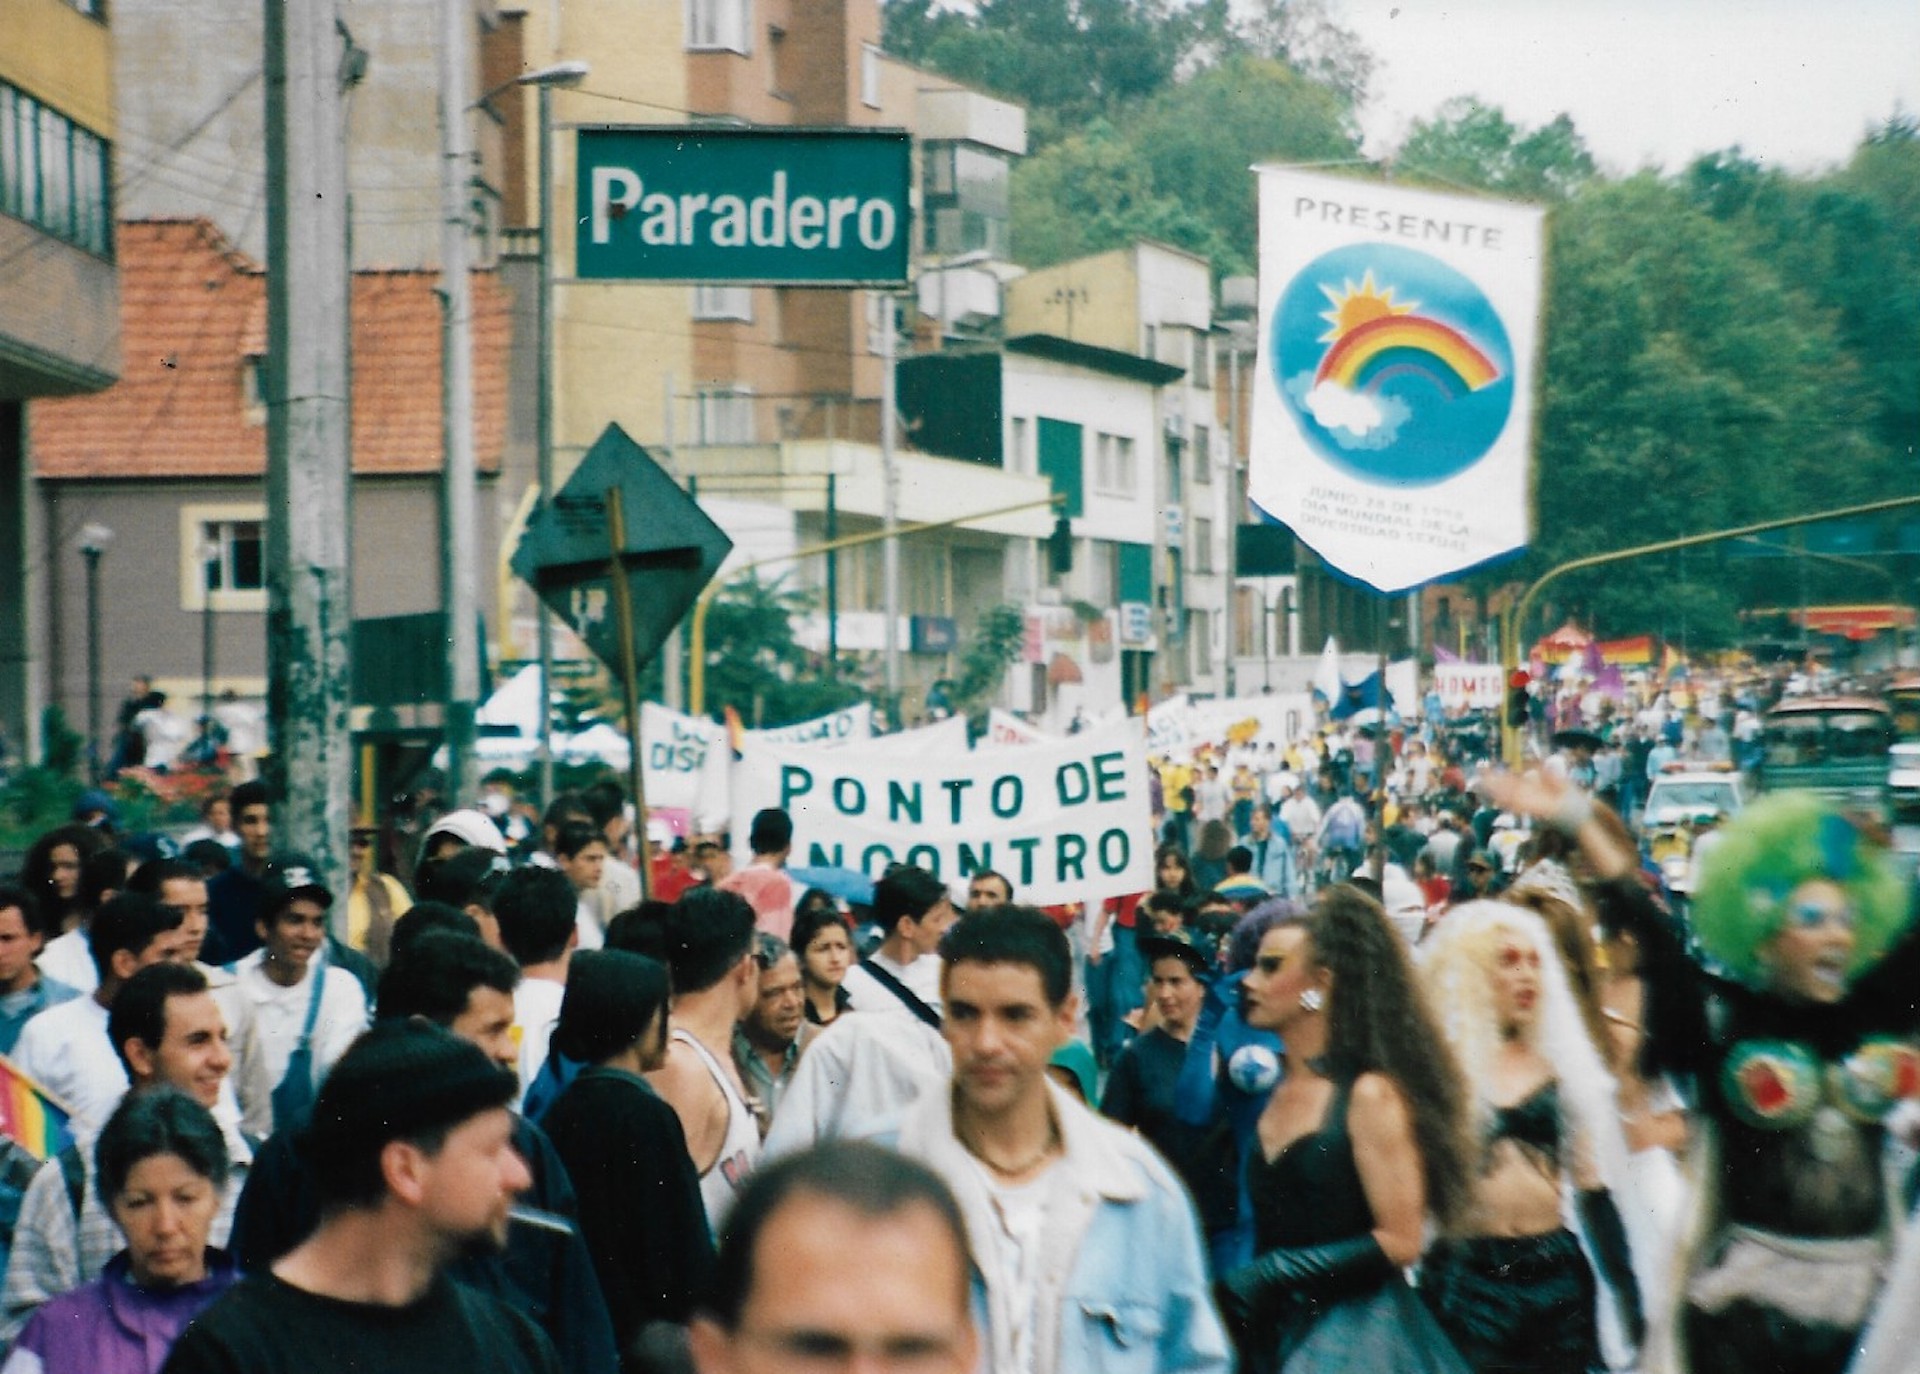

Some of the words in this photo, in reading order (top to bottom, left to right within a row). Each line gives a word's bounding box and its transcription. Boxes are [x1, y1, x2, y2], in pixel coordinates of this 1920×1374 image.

[591, 166, 896, 250] Paradero
[1294, 196, 1503, 251] PRESENTE
[1335, 507, 1412, 528] MUNDIAL
[779, 764, 1024, 824] PONTO
[1056, 751, 1126, 806] DE
[809, 828, 1130, 885] NCONTRO
